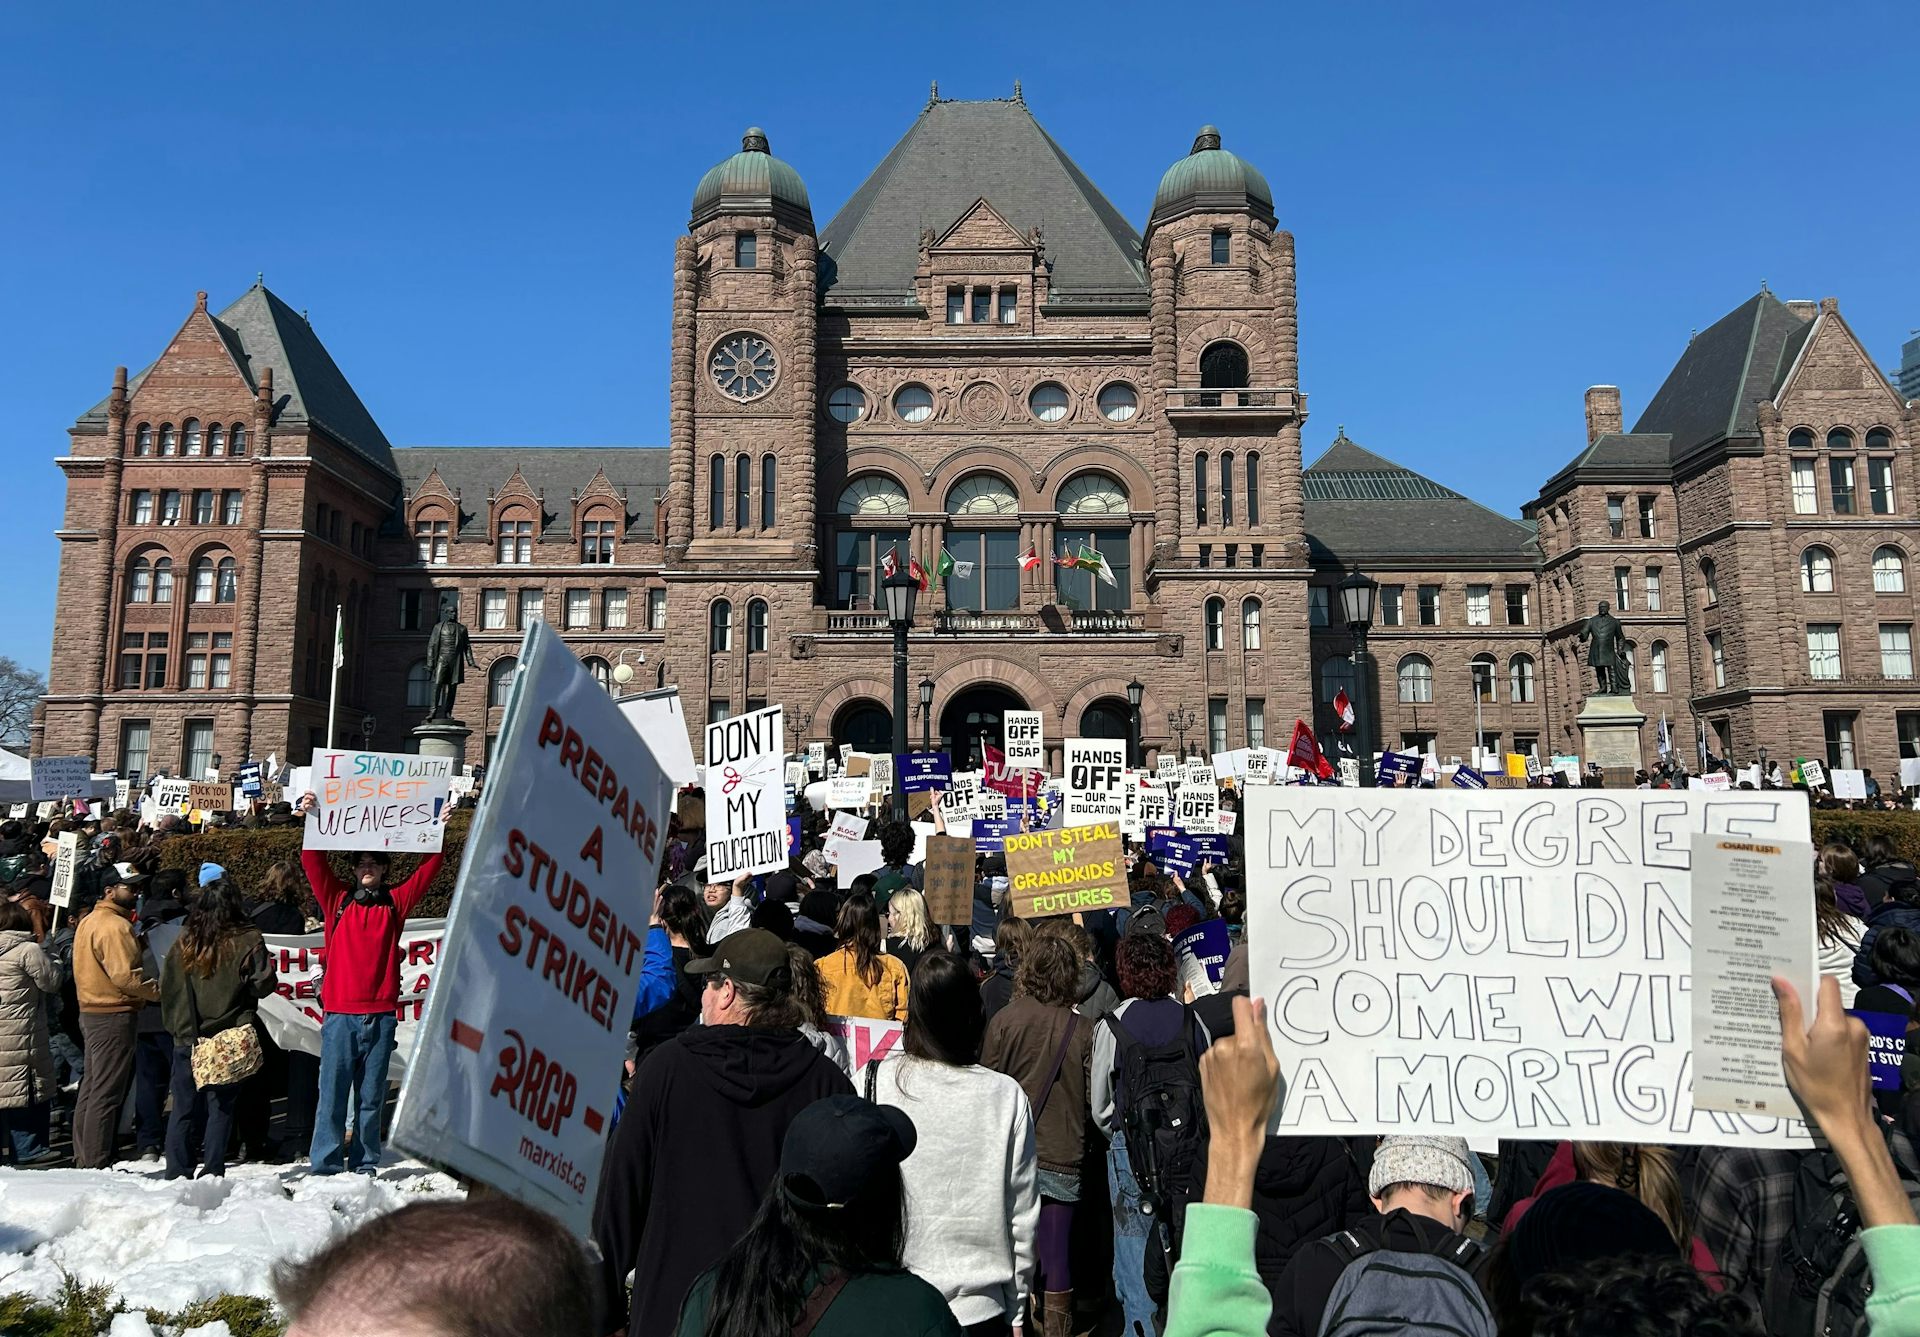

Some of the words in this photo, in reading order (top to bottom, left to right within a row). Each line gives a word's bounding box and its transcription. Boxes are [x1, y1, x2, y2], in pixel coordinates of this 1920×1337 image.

[709, 709, 782, 768] DON'T
[1008, 726, 1039, 739] OFF
[1009, 747, 1040, 757] OSAP
[1072, 750, 1122, 764] HANDS
[323, 754, 345, 778] I
[354, 754, 404, 776] STAND
[408, 760, 448, 778] WITH
[1248, 760, 1267, 769] OFF
[1805, 768, 1819, 776] OFF
[538, 706, 658, 865] PREPARE
[1072, 765, 1122, 790] OFF
[1193, 774, 1212, 783] OFF
[1496, 776, 1517, 787] PROUD
[190, 785, 209, 796] FUCK
[212, 786, 227, 796] YOU
[324, 778, 428, 804] BASKET
[944, 788, 974, 808] OFF
[1085, 792, 1106, 802] OUR
[1183, 792, 1214, 801] HANDS
[198, 799, 225, 809] FORD!
[1140, 796, 1164, 804] ANDS
[318, 797, 444, 836] WEAVERS!
[727, 788, 762, 836] MY
[1071, 804, 1121, 814] EDUCATION
[1183, 801, 1214, 817] OFF
[947, 813, 978, 823] EDUCATION
[836, 826, 858, 837] BLOCK
[1006, 832, 1054, 853] DON'T
[1060, 824, 1118, 845] STEAL
[1268, 807, 1396, 868] MY
[59, 846, 72, 858] DROP
[580, 824, 604, 875] A
[710, 830, 783, 876] EDUCATION
[1052, 847, 1075, 864] MY
[1722, 842, 1754, 852] CHANT
[1756, 846, 1774, 854] LIST
[58, 858, 70, 874] FEES
[54, 872, 70, 888] NOT
[503, 828, 641, 976] STUDENT
[1033, 887, 1113, 912] FUTURES
[1188, 932, 1204, 943] CUTS
[498, 904, 620, 1032] STRIKE!
[1275, 970, 1521, 1046] COME
[1546, 974, 1692, 1041] WI
[518, 1047, 578, 1138] RCP
[1280, 1058, 1357, 1126] A
[1376, 1045, 1818, 1138] MORTGA
[519, 1135, 586, 1194] marxist.ca
